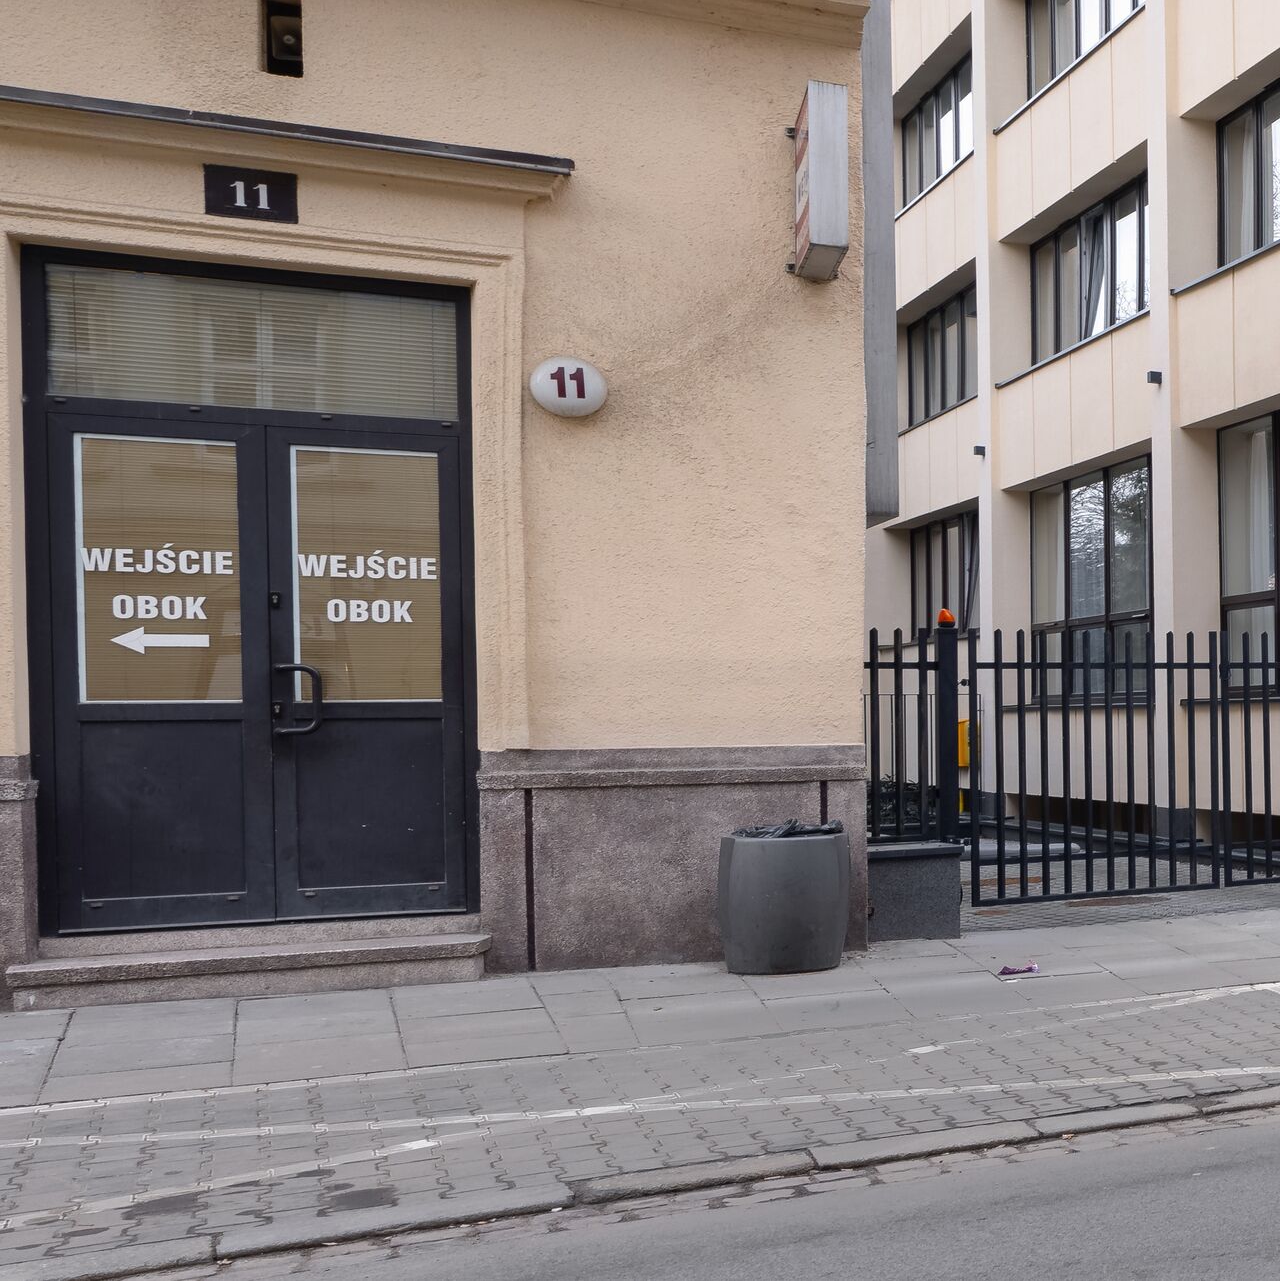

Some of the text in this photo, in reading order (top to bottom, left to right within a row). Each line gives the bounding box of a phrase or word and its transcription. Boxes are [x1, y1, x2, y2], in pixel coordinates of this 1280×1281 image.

[229, 180, 271, 210] 11
[549, 366, 586, 399] 11
[80, 542, 235, 575] WEJŚCIE
[297, 549, 438, 580] WEJŚCIE
[112, 594, 208, 620] OBOK
[326, 598, 414, 623] OBOK
